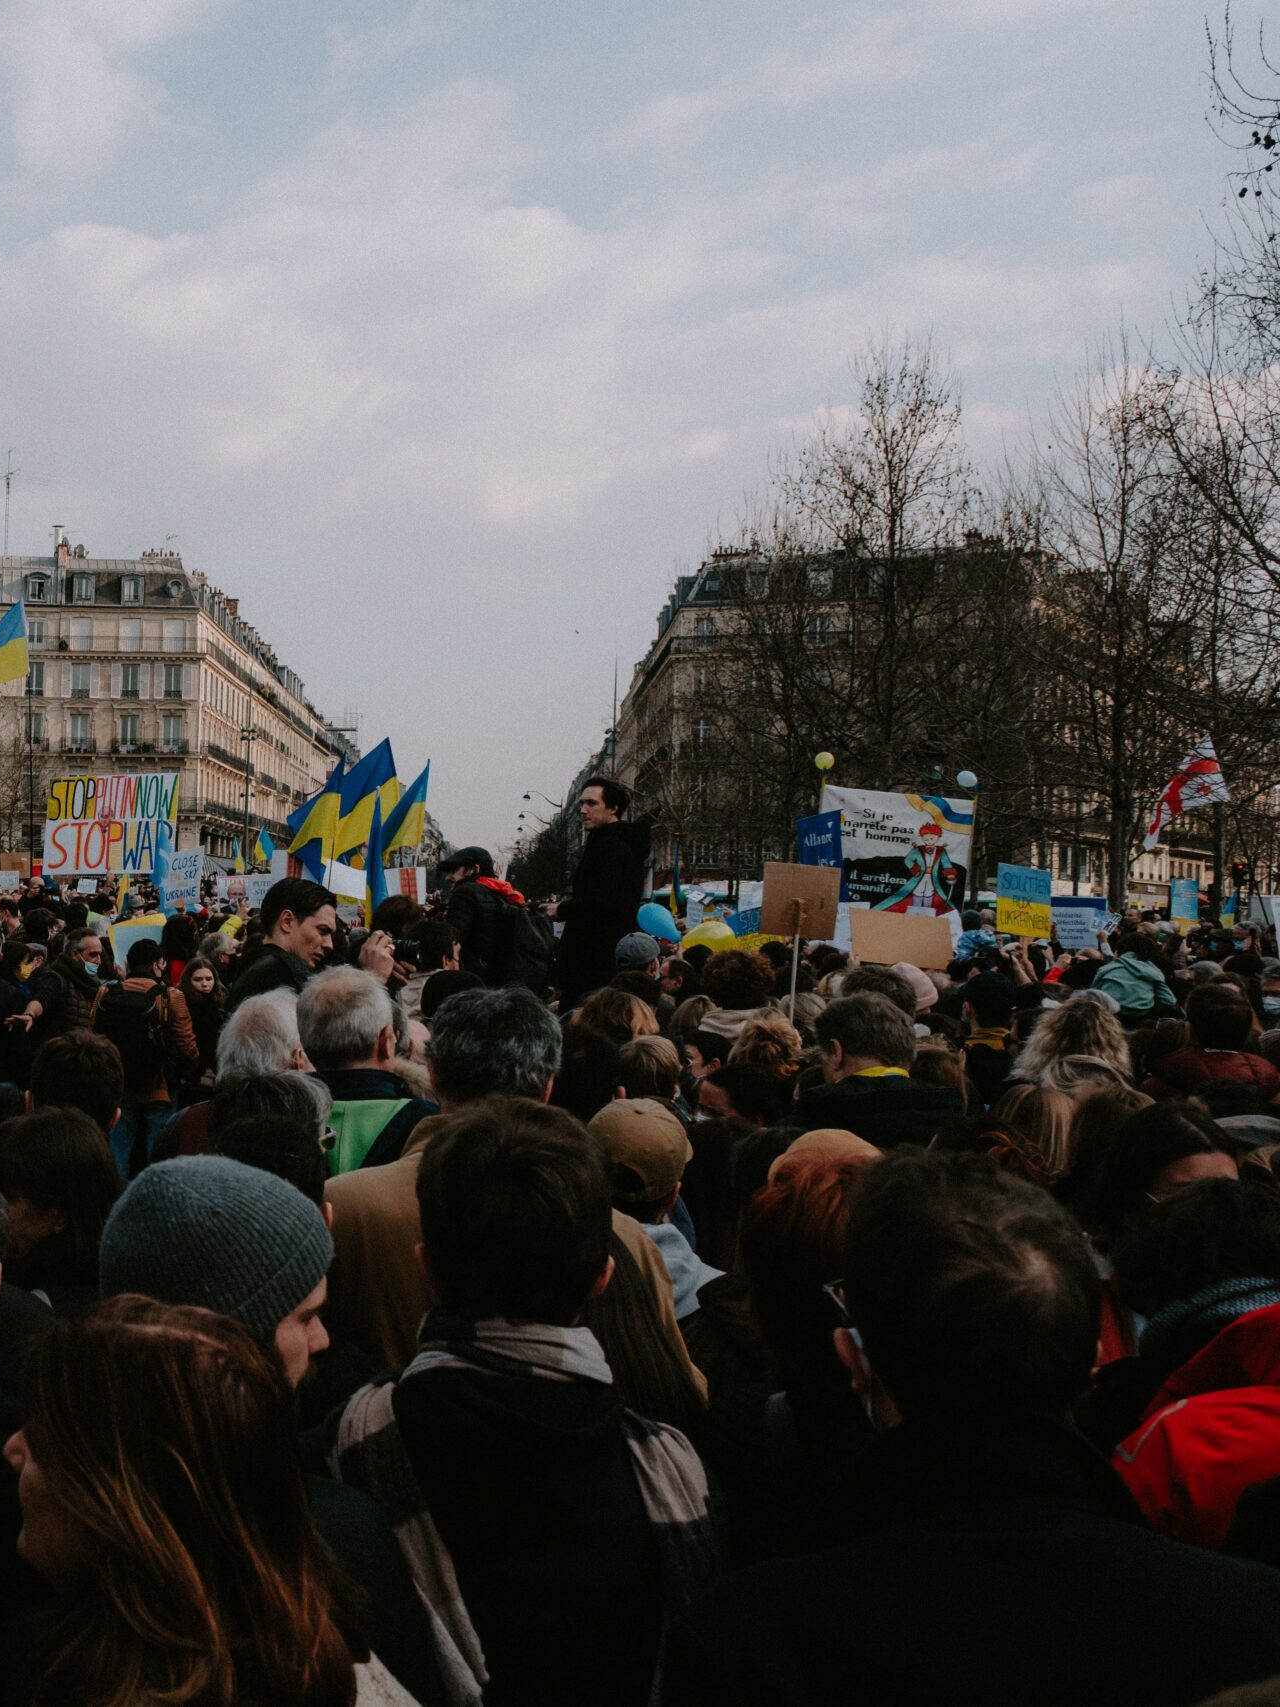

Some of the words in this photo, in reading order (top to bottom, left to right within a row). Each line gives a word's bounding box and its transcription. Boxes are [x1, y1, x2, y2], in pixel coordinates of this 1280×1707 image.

[49, 779, 96, 821] STOP
[92, 776, 138, 820] PUTIN
[134, 775, 178, 819] NOW
[880, 812, 894, 822] je
[866, 830, 911, 844] homme
[891, 826, 915, 835] pas
[48, 821, 124, 870] STOP
[171, 855, 199, 871] CLOSE
[184, 869, 200, 880] SKY
[850, 869, 859, 880] il
[166, 886, 197, 902] UKRAINE
[739, 910, 760, 929] STO
